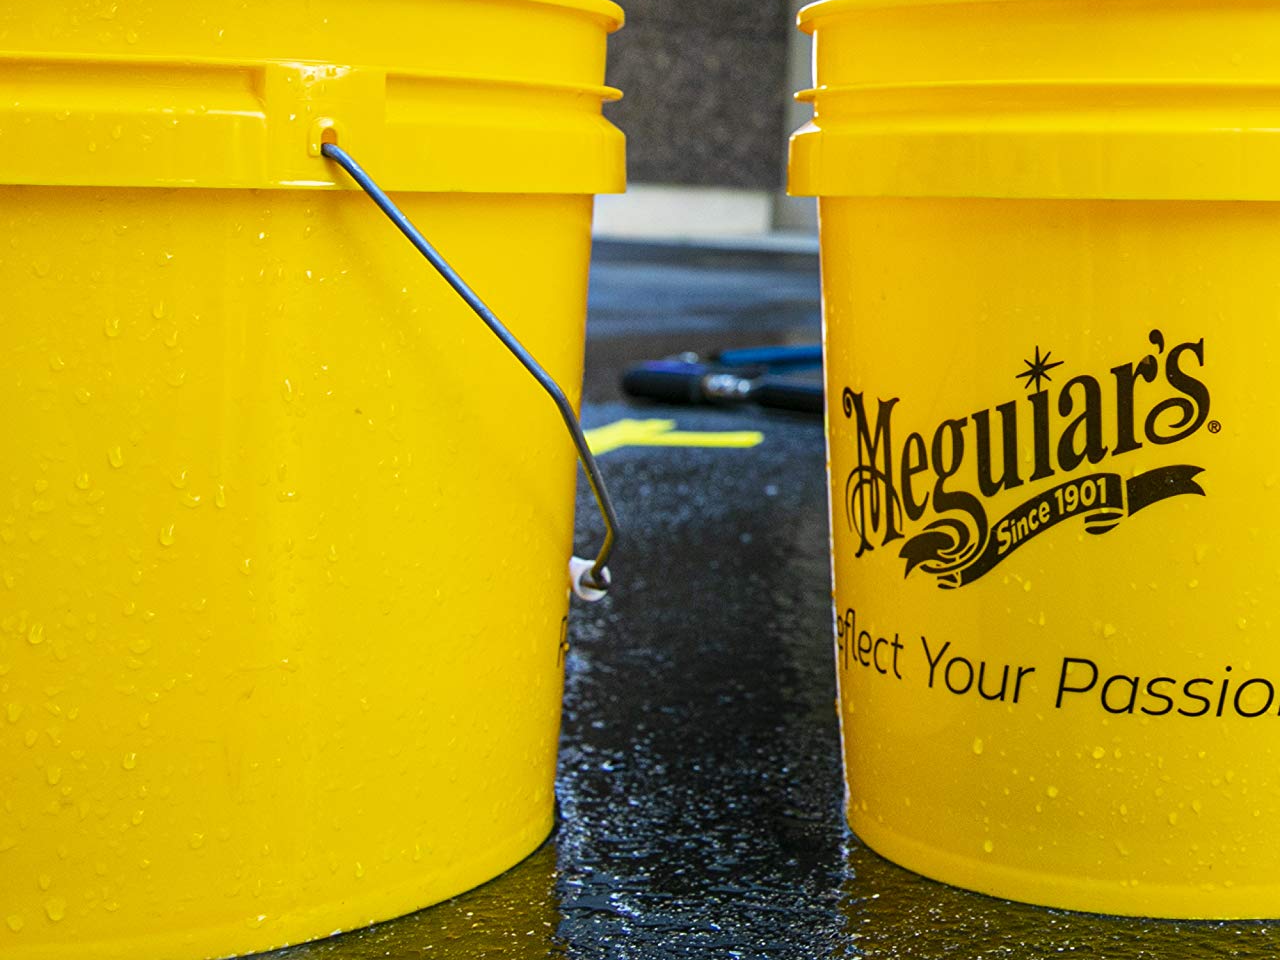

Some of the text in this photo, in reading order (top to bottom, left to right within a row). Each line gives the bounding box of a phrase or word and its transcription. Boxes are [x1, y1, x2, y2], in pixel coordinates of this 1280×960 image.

[996, 476, 1107, 556] Since 1901
[920, 635, 1036, 704] Your
